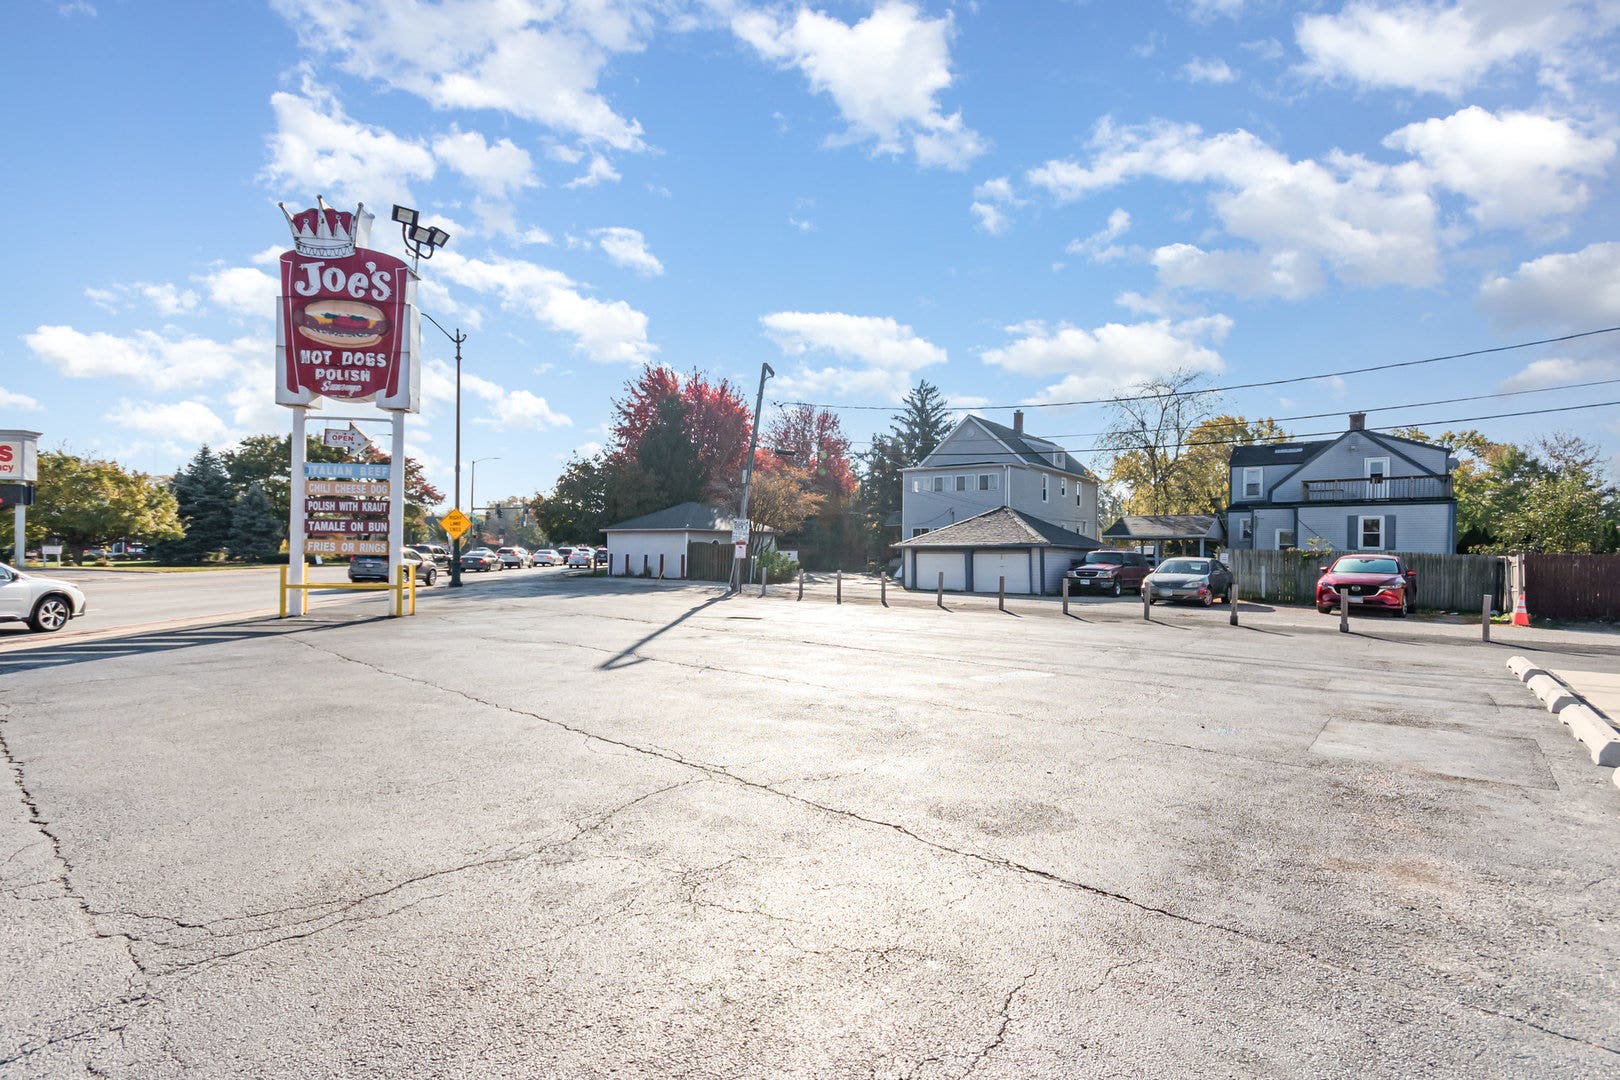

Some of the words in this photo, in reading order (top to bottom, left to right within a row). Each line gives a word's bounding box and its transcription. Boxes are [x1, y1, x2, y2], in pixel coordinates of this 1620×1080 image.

[294, 261, 393, 301] Joe's
[300, 349, 332, 364] HOT
[342, 352, 387, 368] DOGS
[315, 368, 370, 382] POLISH
[332, 434, 354, 442] OPEN
[308, 466, 353, 476] ITALIAN
[359, 467, 388, 477] BEEF
[308, 483, 331, 493] CHILI
[335, 483, 366, 494] CHEESE
[371, 484, 388, 494] DOG
[308, 500, 335, 511] POLISH
[339, 501, 358, 511] WITH
[362, 502, 387, 512] KRAUT
[308, 521, 345, 531] TAMALE
[351, 522, 363, 532] ON
[368, 522, 387, 532] BUN
[307, 541, 336, 551] FRIES
[341, 542, 354, 552] OR
[359, 542, 387, 553] RINGS
